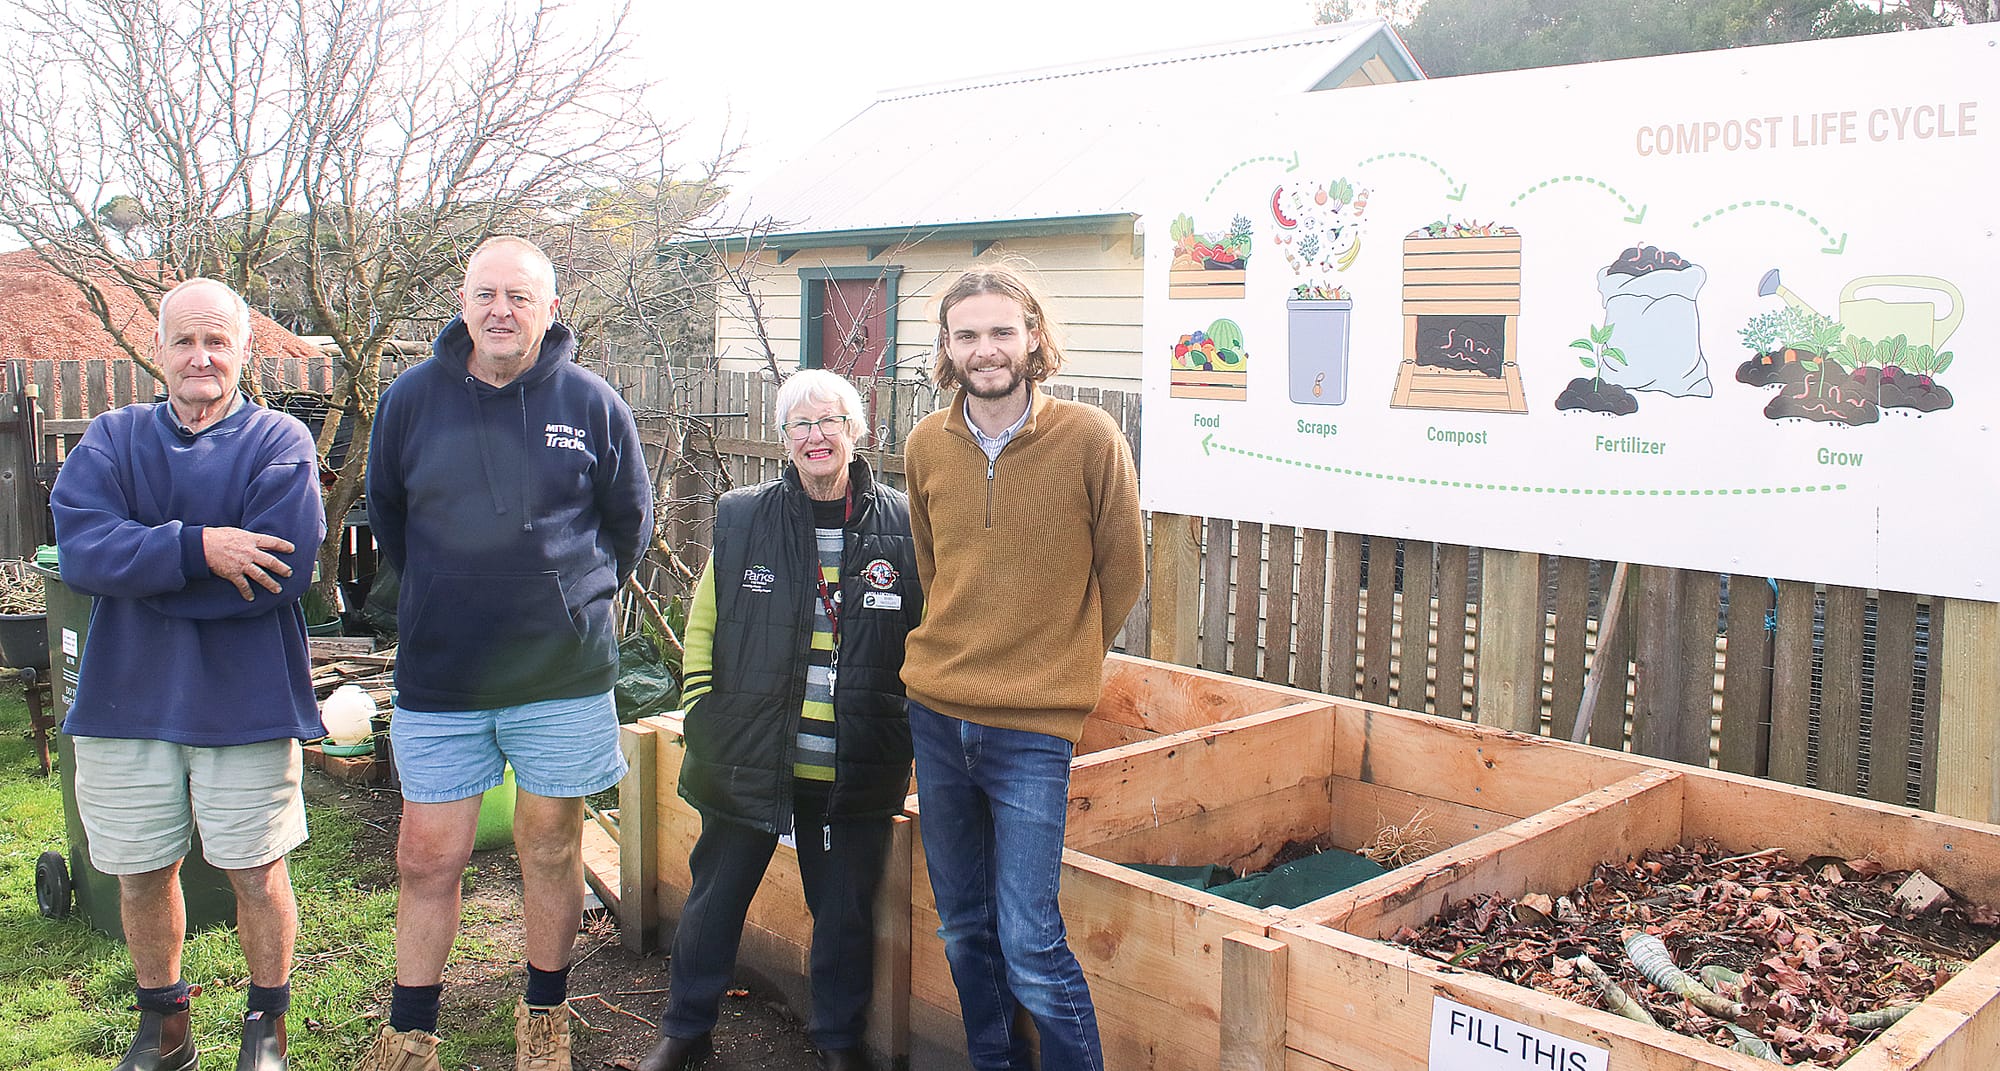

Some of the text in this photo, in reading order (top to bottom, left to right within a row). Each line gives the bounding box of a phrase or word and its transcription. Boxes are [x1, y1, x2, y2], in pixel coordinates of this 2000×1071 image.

[1636, 101, 1978, 156] COMPOST LIFE CYCLE
[1194, 413, 1220, 428] Food
[1297, 419, 1338, 438] Scraps
[545, 423, 586, 438] MITRE 10
[1427, 426, 1487, 446] Compost
[544, 433, 586, 451] Trade
[1595, 435, 1666, 455] Fertilizer
[1817, 447, 1863, 467] Grow
[743, 569, 775, 583] Parks
[1450, 1010, 1587, 1071] FILL THIS
